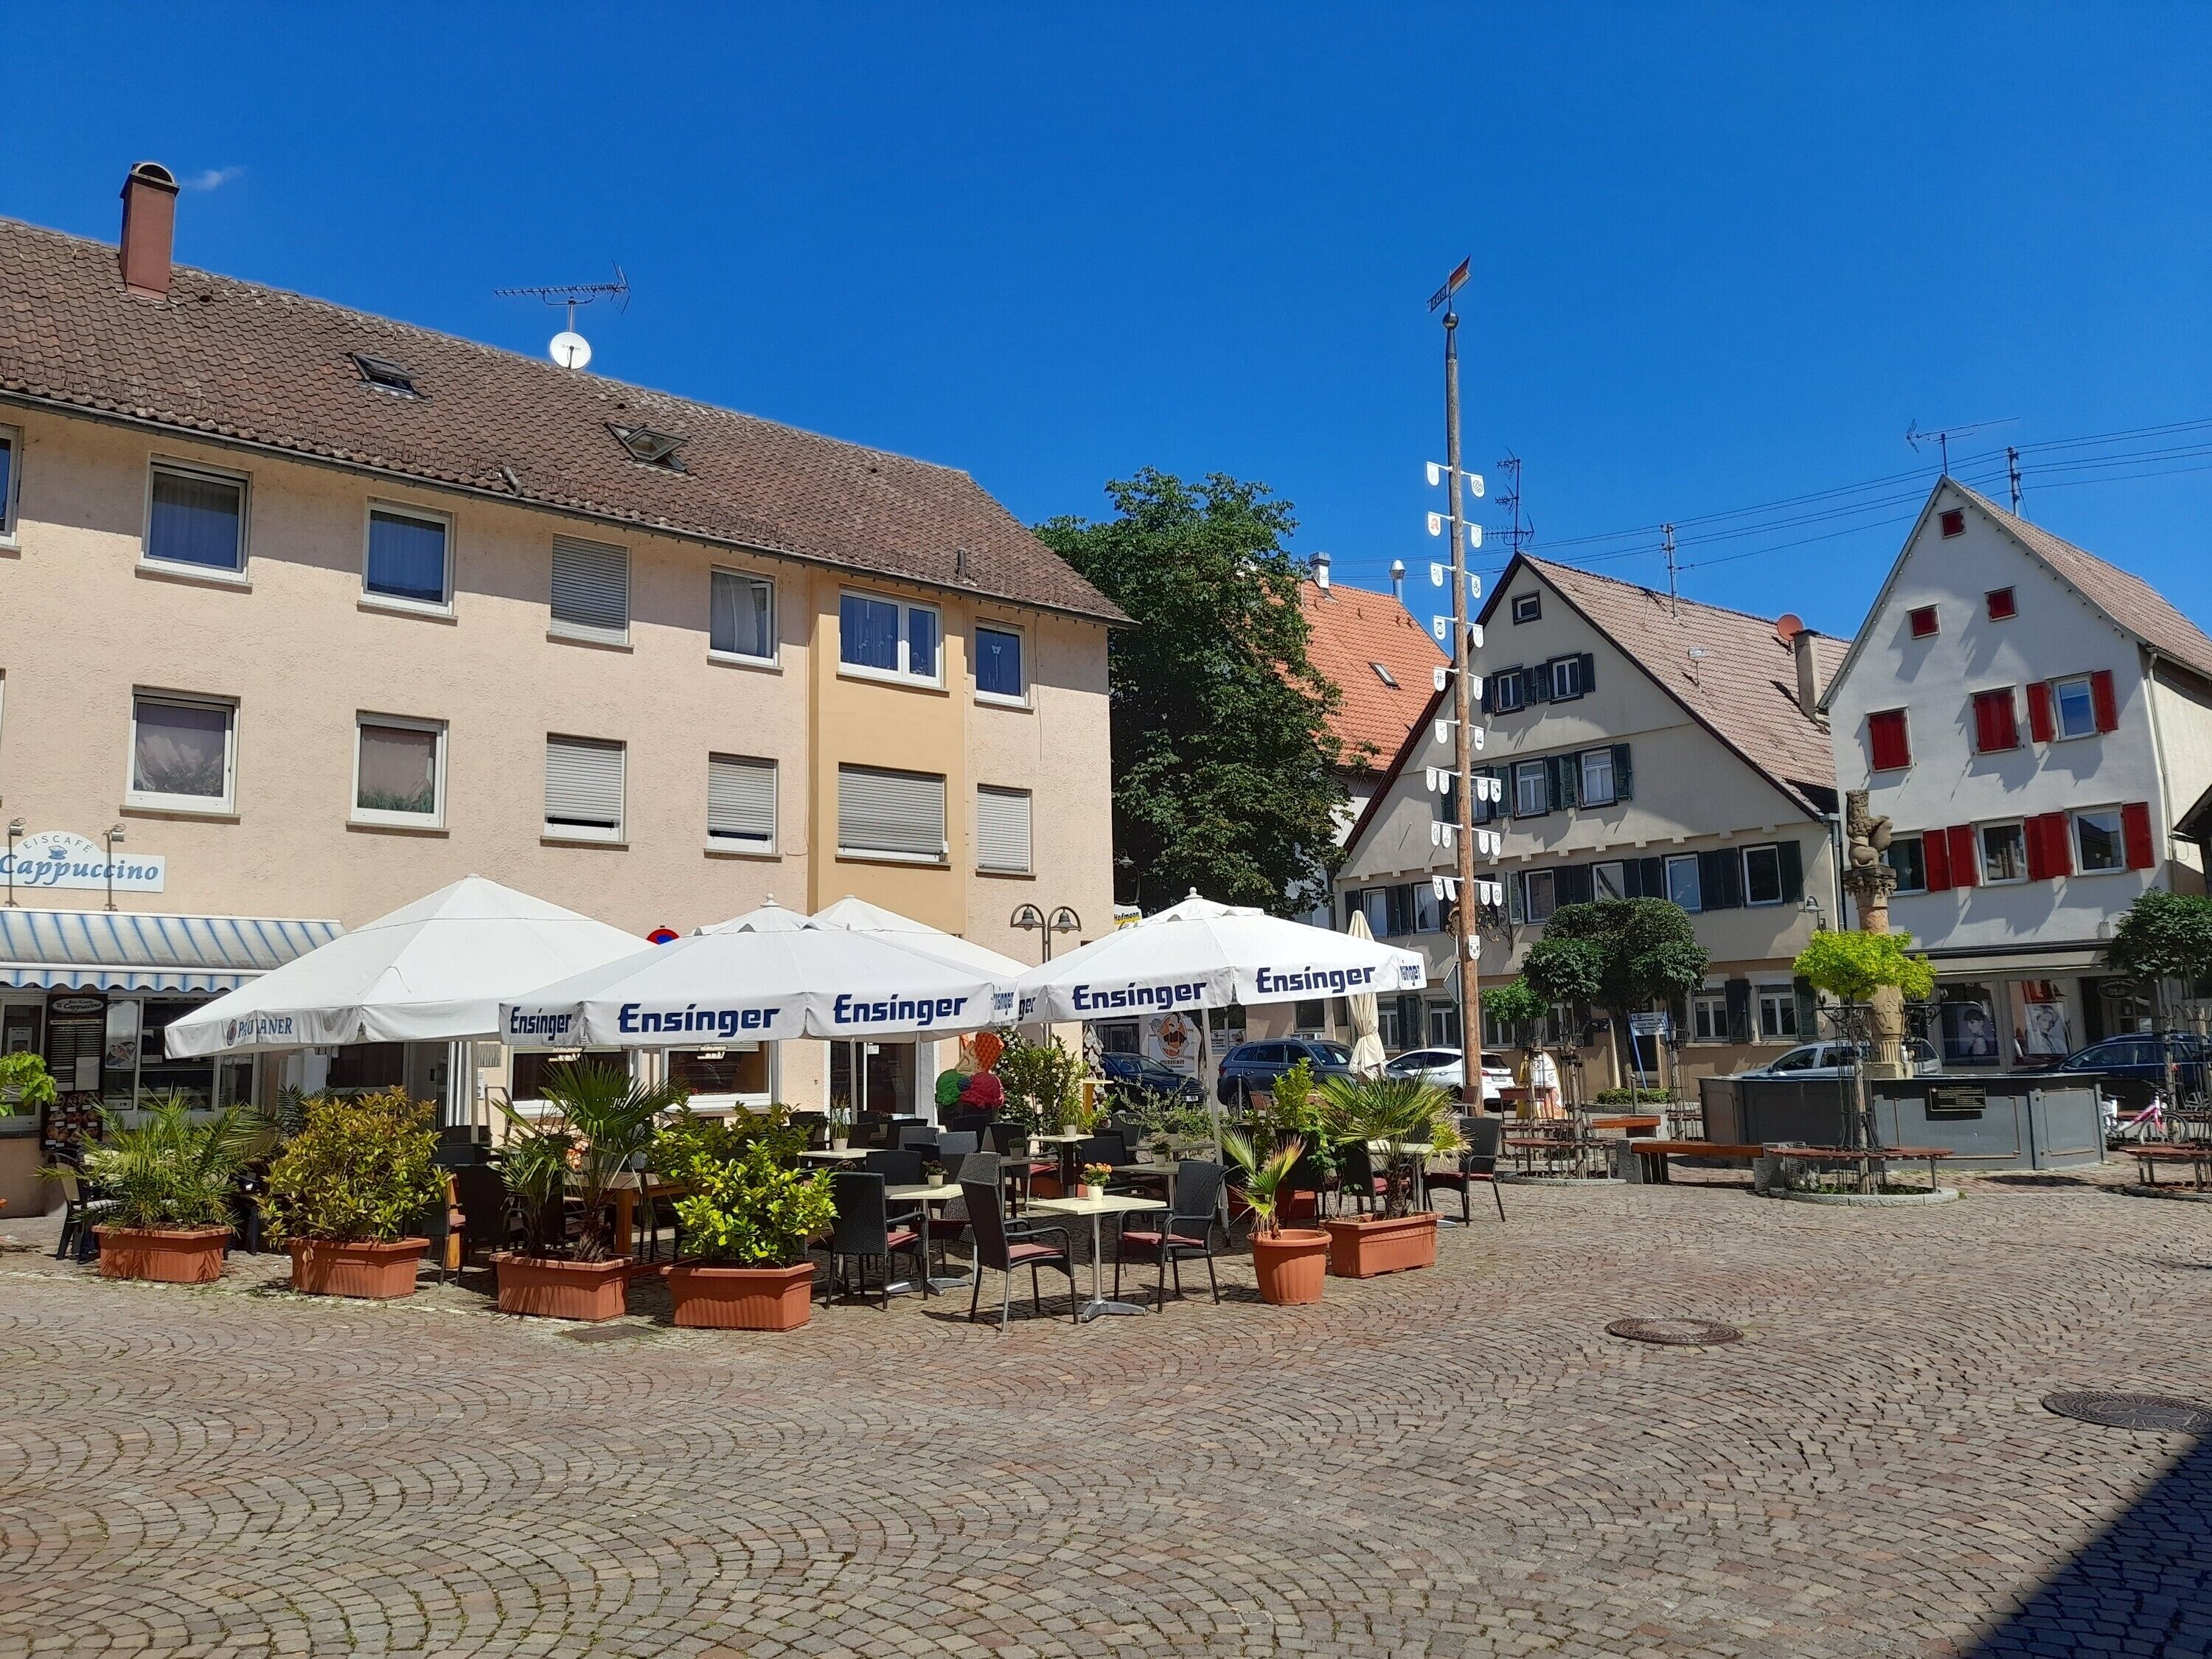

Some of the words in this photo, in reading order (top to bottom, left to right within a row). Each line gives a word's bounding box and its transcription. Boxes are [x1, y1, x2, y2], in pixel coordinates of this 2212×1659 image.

[23, 835, 94, 853] EISCAFÉ
[0, 854, 159, 886] Cappuccino
[1256, 966, 1376, 994] Ensinger
[832, 993, 969, 1026] Ensinger
[1071, 981, 1208, 1010] Ensinger
[237, 1017, 293, 1038] PAULANER
[510, 1006, 573, 1041] Ensinger
[617, 1003, 782, 1038] Ensinger
